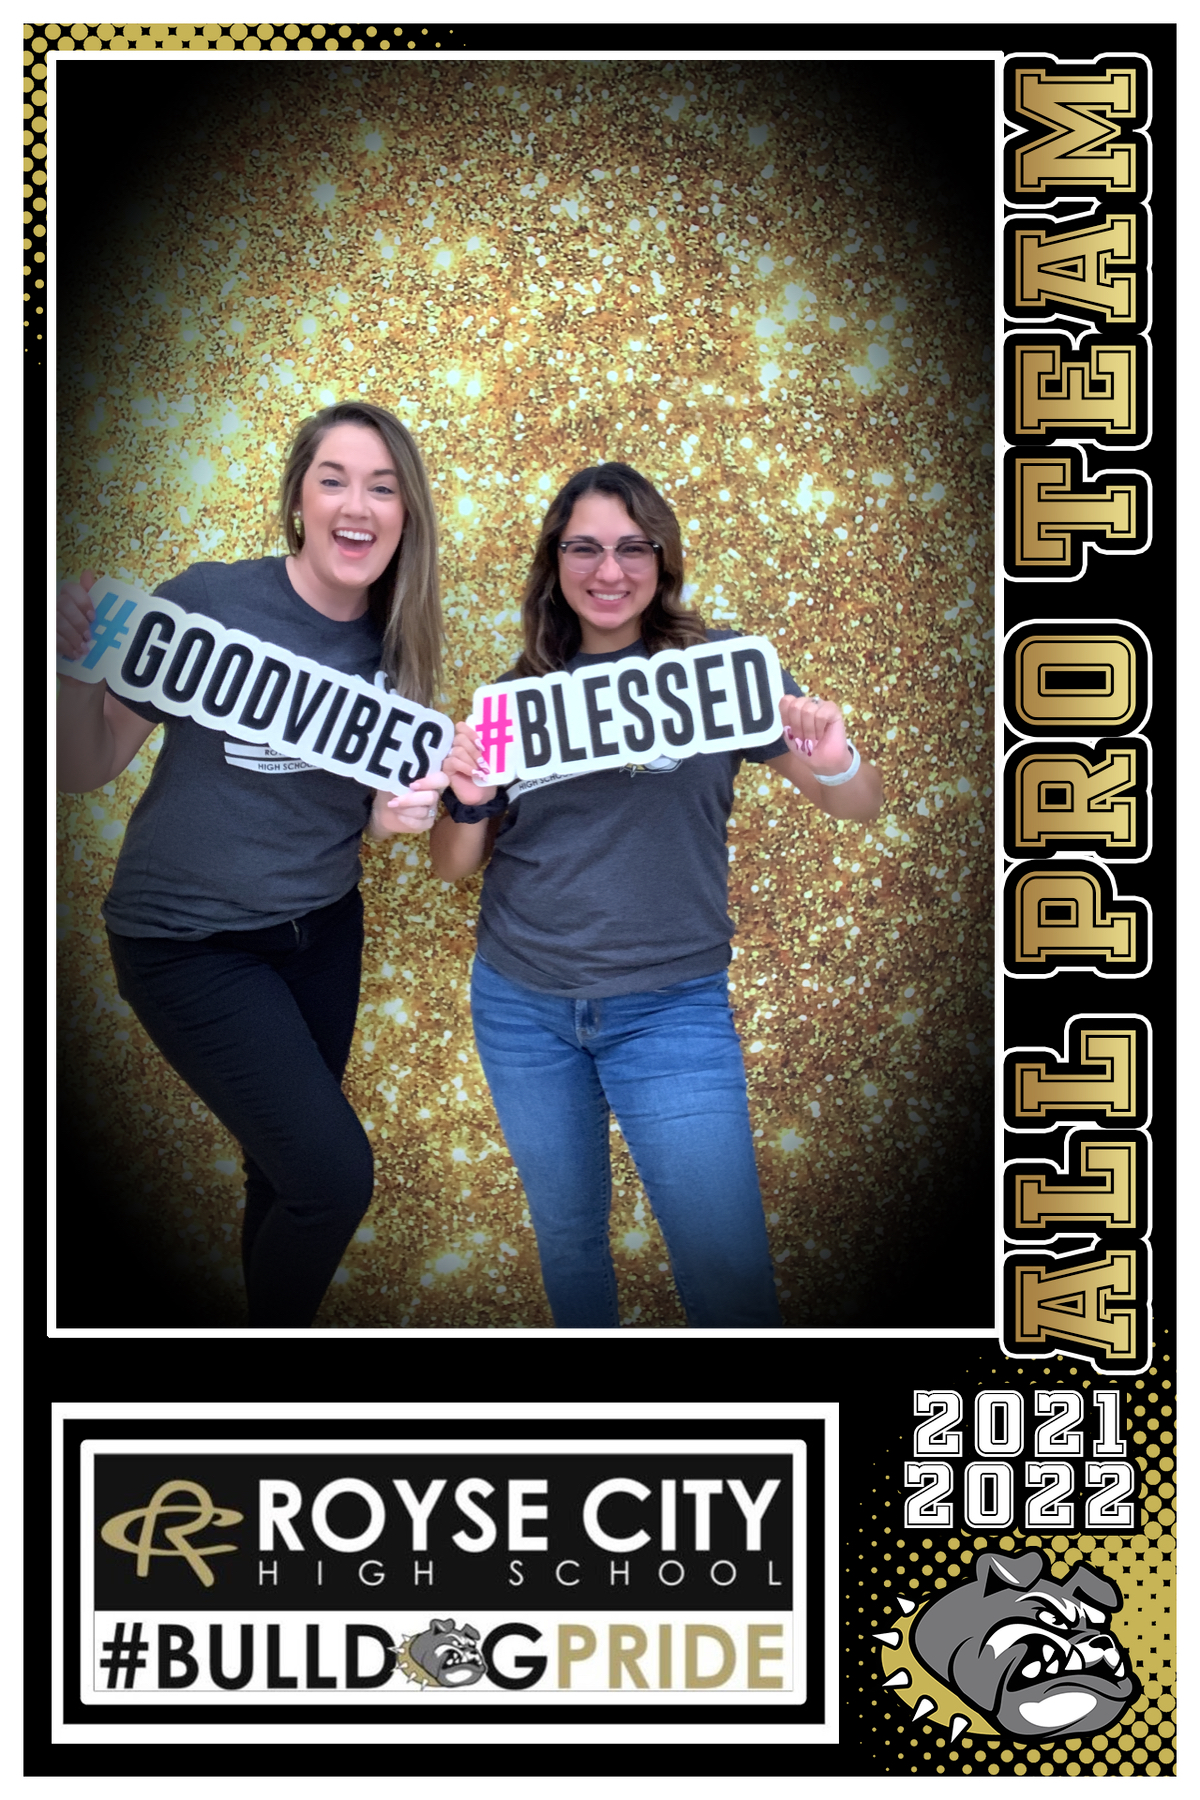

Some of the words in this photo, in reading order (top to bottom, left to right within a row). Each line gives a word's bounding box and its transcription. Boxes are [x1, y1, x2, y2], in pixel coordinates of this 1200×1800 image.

[62, 591, 443, 788] #GOODVIBES
[475, 648, 775, 773] #BLESSED
[258, 763, 281, 771] HIGH
[519, 779, 539, 791] HIGH
